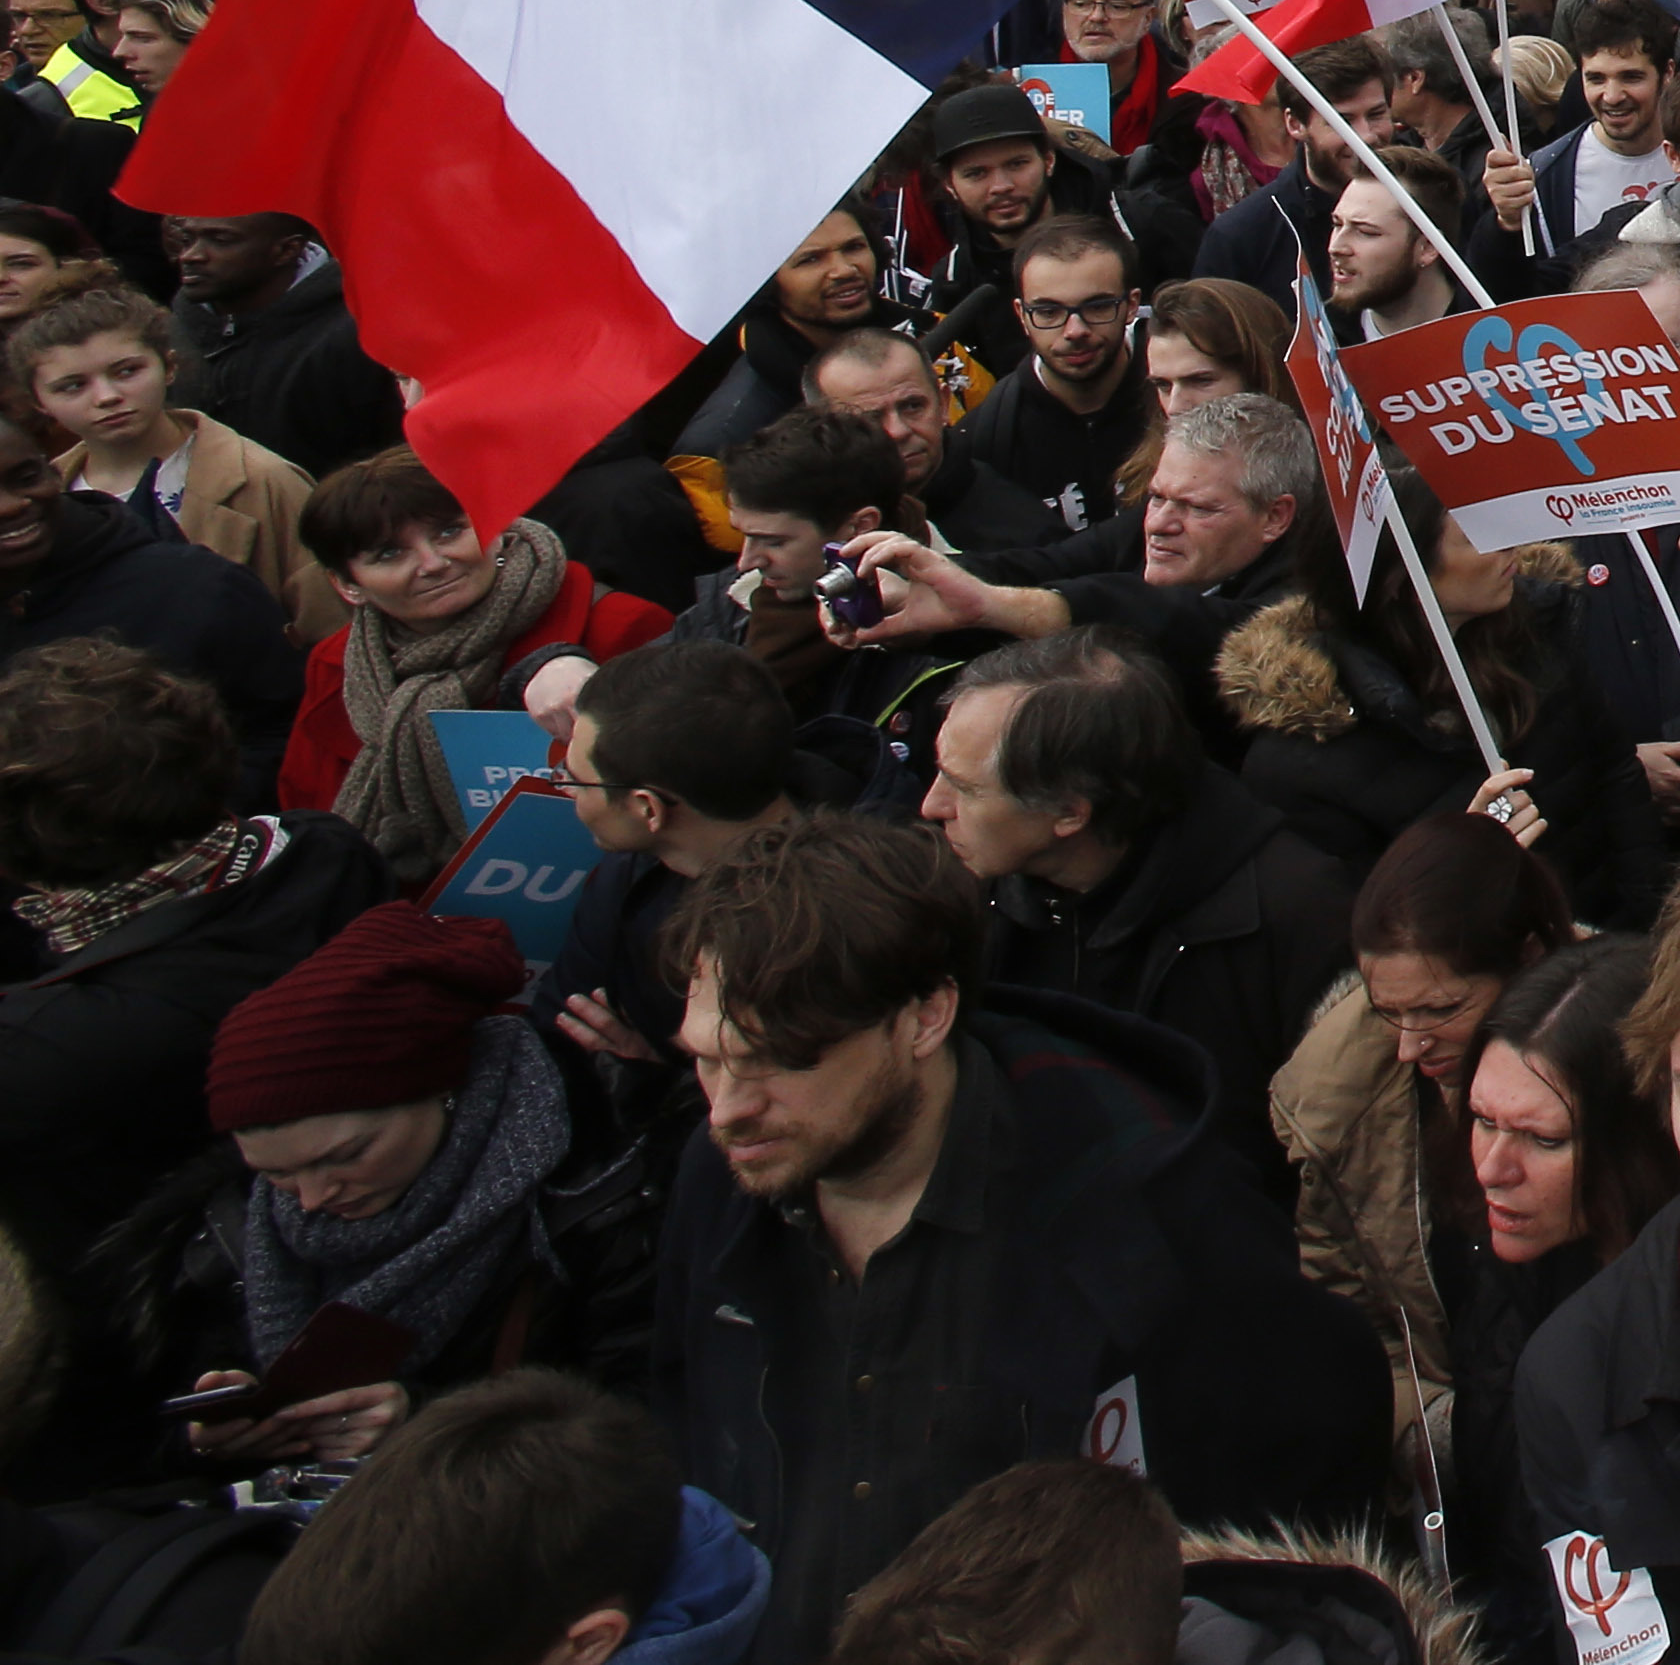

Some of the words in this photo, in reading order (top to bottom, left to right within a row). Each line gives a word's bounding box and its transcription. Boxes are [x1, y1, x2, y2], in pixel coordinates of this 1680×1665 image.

[1379, 343, 1680, 424] SUPPRESSION
[1428, 409, 1516, 456] DU
[1520, 384, 1678, 436] SÉNAT
[1571, 483, 1671, 509] Mélenchon
[1590, 504, 1625, 518] France
[224, 833, 259, 884] Cano
[464, 858, 587, 903] DU
[1581, 1620, 1663, 1665] Mélenchon
